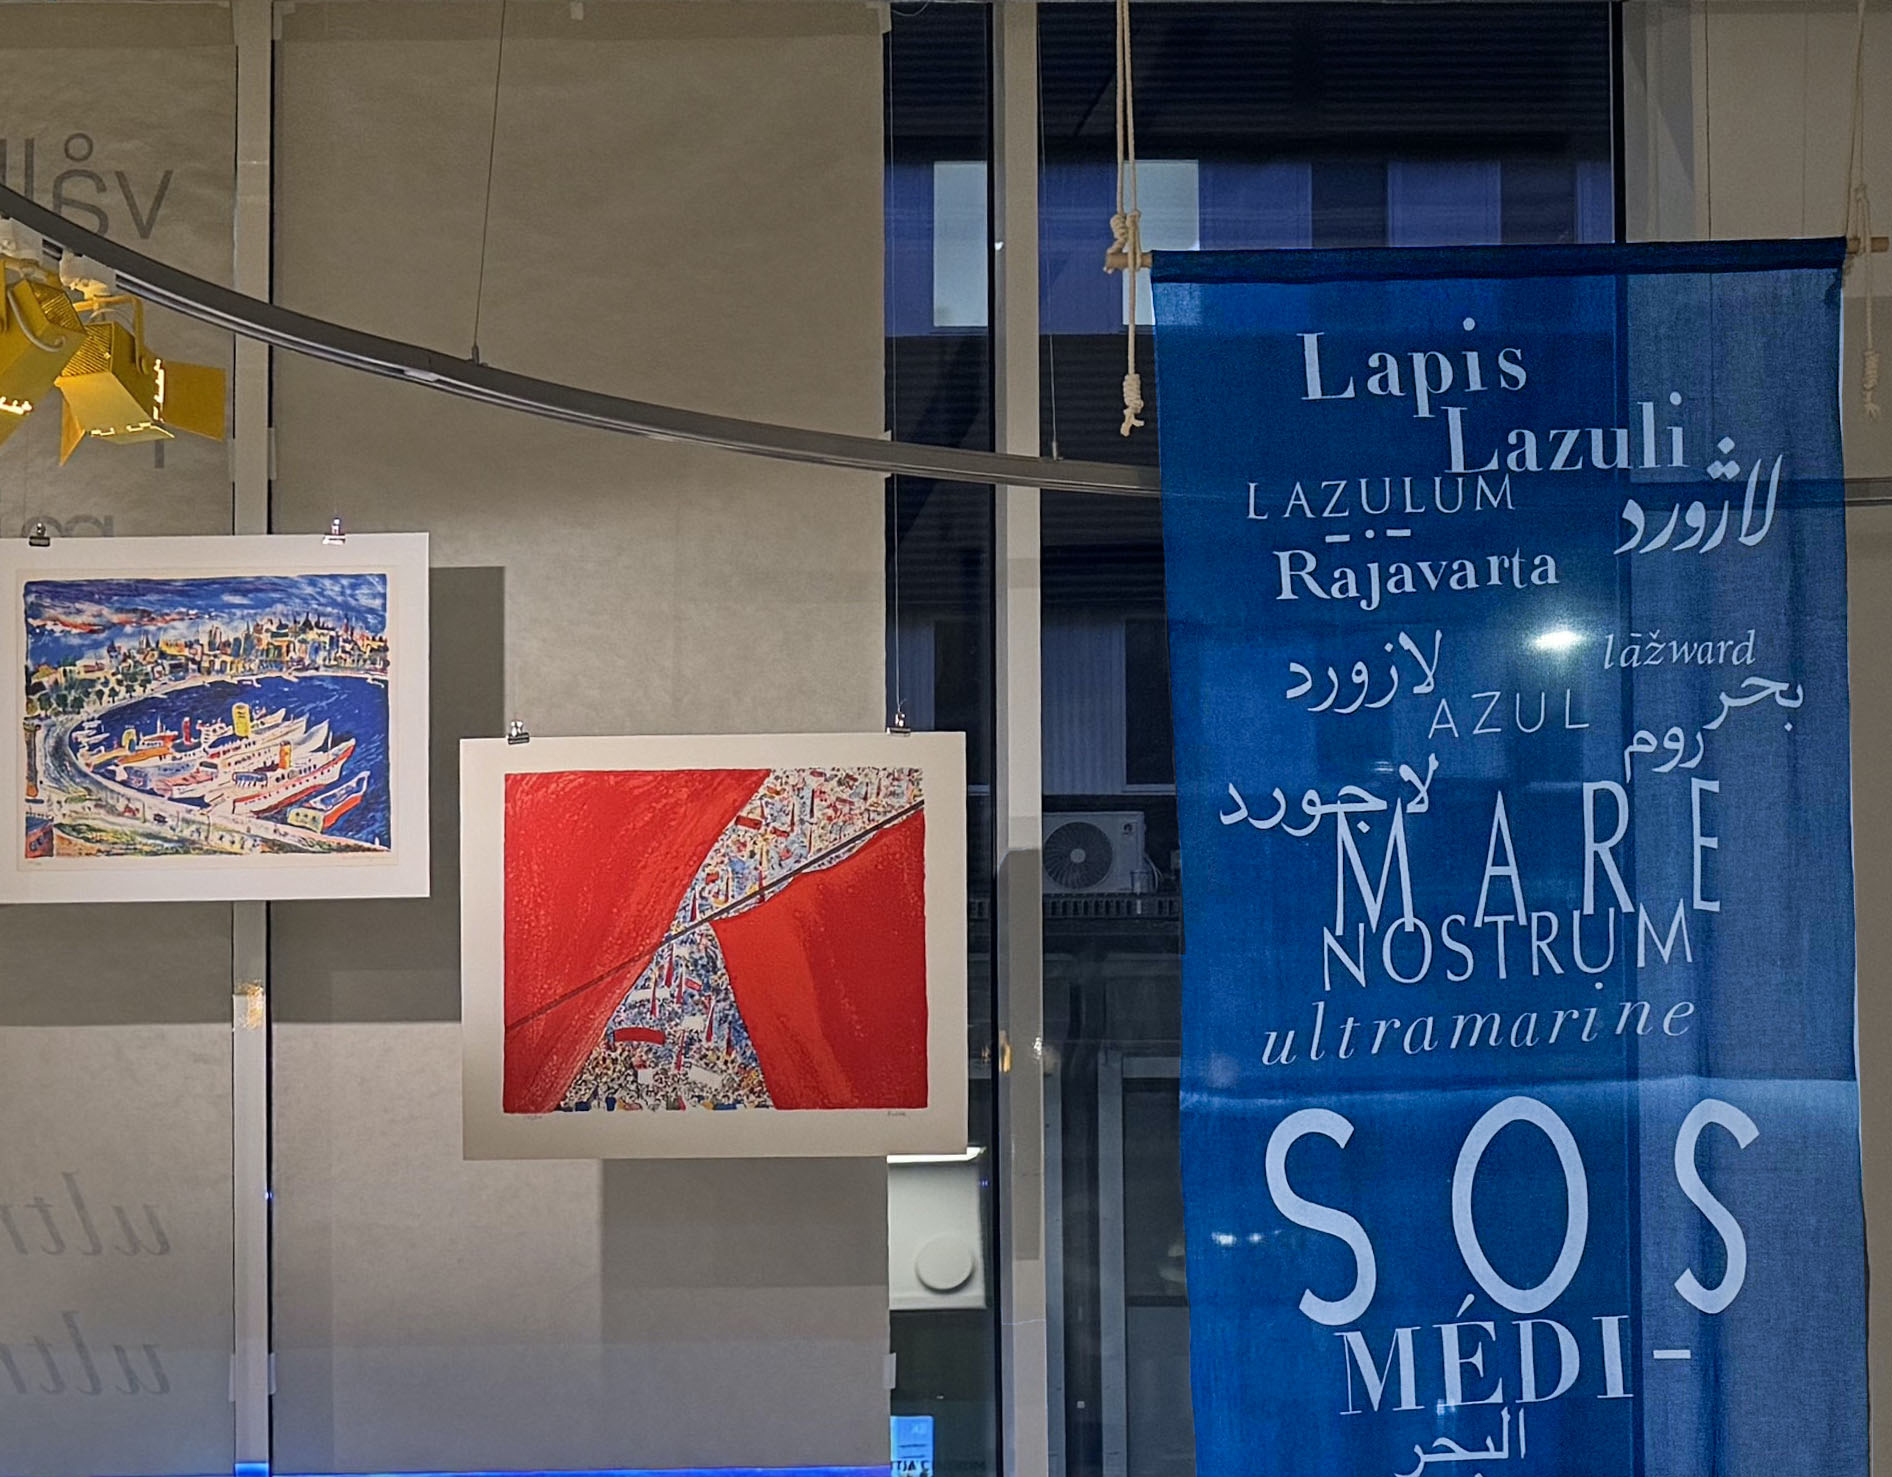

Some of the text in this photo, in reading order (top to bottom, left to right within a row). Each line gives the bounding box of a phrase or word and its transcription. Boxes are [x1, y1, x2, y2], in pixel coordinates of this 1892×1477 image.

[1296, 317, 1528, 418] Lapis
[1440, 391, 1691, 475] Lazuli
[1247, 473, 1516, 521] LAZULUM
[1285, 629, 1443, 715] لازورد
[1428, 688, 1591, 740] AZUL
[1623, 675, 1805, 784] بحر روم
[1334, 776, 1722, 937] MARE
[1322, 897, 1694, 991] NOSTRUM
[1261, 981, 1696, 1066] ultramarine
[1264, 1095, 1761, 1327] SOS
[1333, 1293, 1692, 1415] MÉDI-
